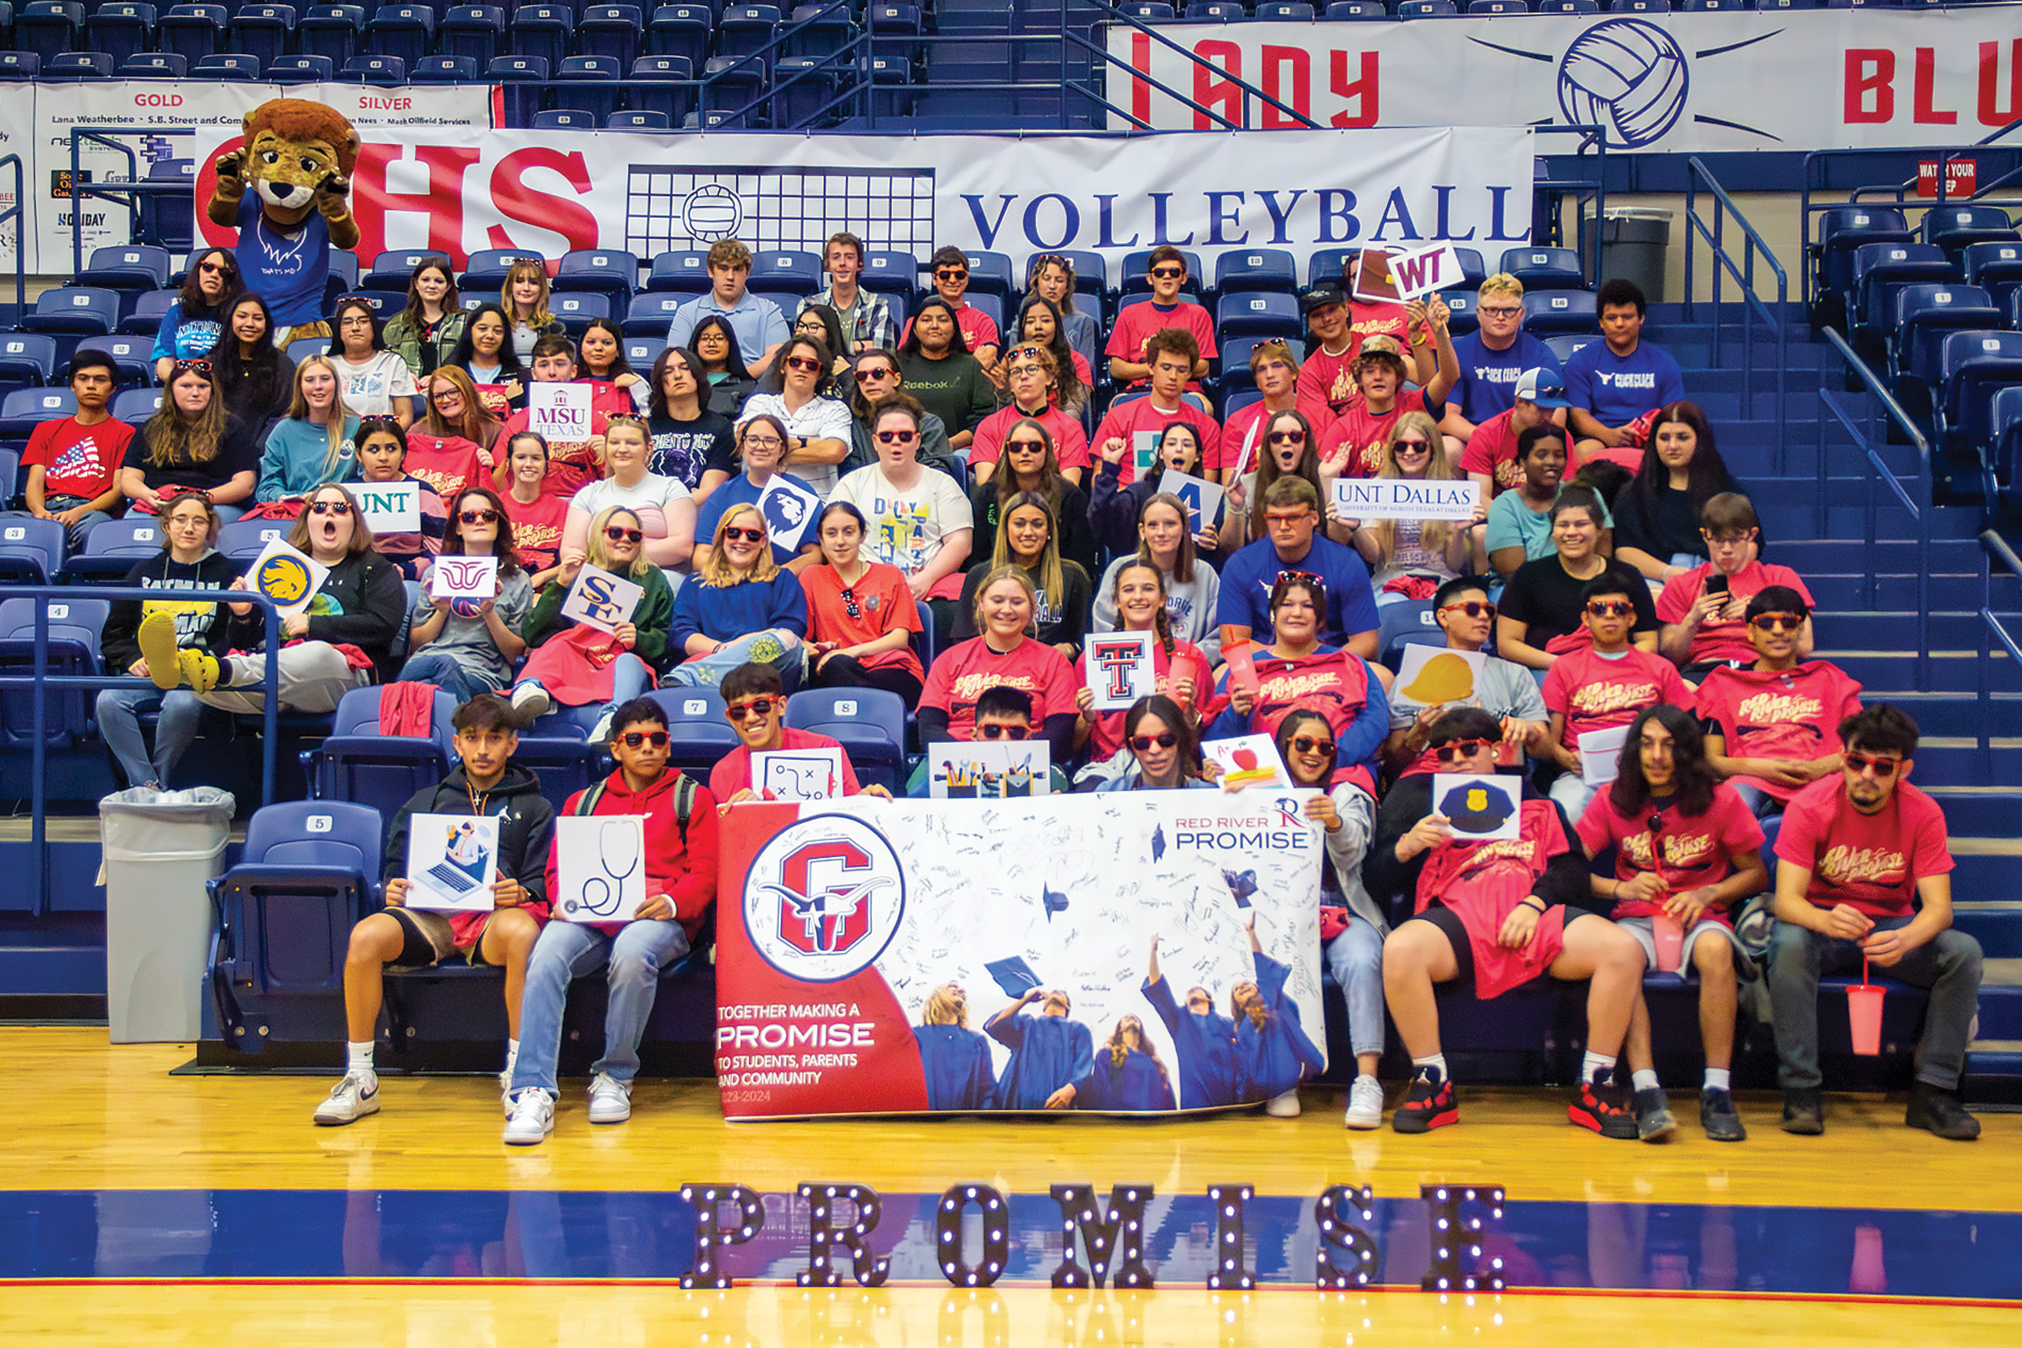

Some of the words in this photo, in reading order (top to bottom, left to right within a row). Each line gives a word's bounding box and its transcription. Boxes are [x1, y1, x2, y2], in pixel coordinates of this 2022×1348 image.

[134, 93, 184, 107] GOLD
[358, 96, 412, 111] SILVER
[52, 115, 75, 124] Lana
[77, 115, 135, 124] Weatherbee
[147, 116, 167, 124] S.B.
[168, 115, 198, 124] Street
[200, 116, 218, 124] and
[1950, 163, 1974, 177] YOUR
[960, 185, 1533, 251] VOLLEYBALL
[1395, 246, 1448, 294] WT
[903, 380, 949, 390] Reebok
[536, 407, 587, 425] MSU
[536, 424, 586, 436] TEXAS
[1338, 484, 1384, 503] UNT
[11, 529, 19, 538] 3
[140, 531, 148, 539] 4
[54, 607, 62, 616] 4
[690, 702, 699, 712] 7
[841, 702, 850, 713] 8
[315, 818, 325, 829] 5
[1175, 818, 1212, 828] RED
[1216, 817, 1269, 828] RIVER
[1176, 832, 1309, 850] PROMISE
[718, 1004, 787, 1020] TOGETHER
[789, 1003, 847, 1018] MAKING
[848, 1002, 861, 1017] A
[716, 1022, 876, 1050] PROMISE
[718, 1057, 731, 1069] TO
[732, 1054, 800, 1069] STUDENTS,
[801, 1053, 858, 1067] PARENTS
[718, 1074, 740, 1087] AND
[741, 1071, 823, 1086] COMMUNITY
[680, 1181, 1507, 1291] PROMISE
